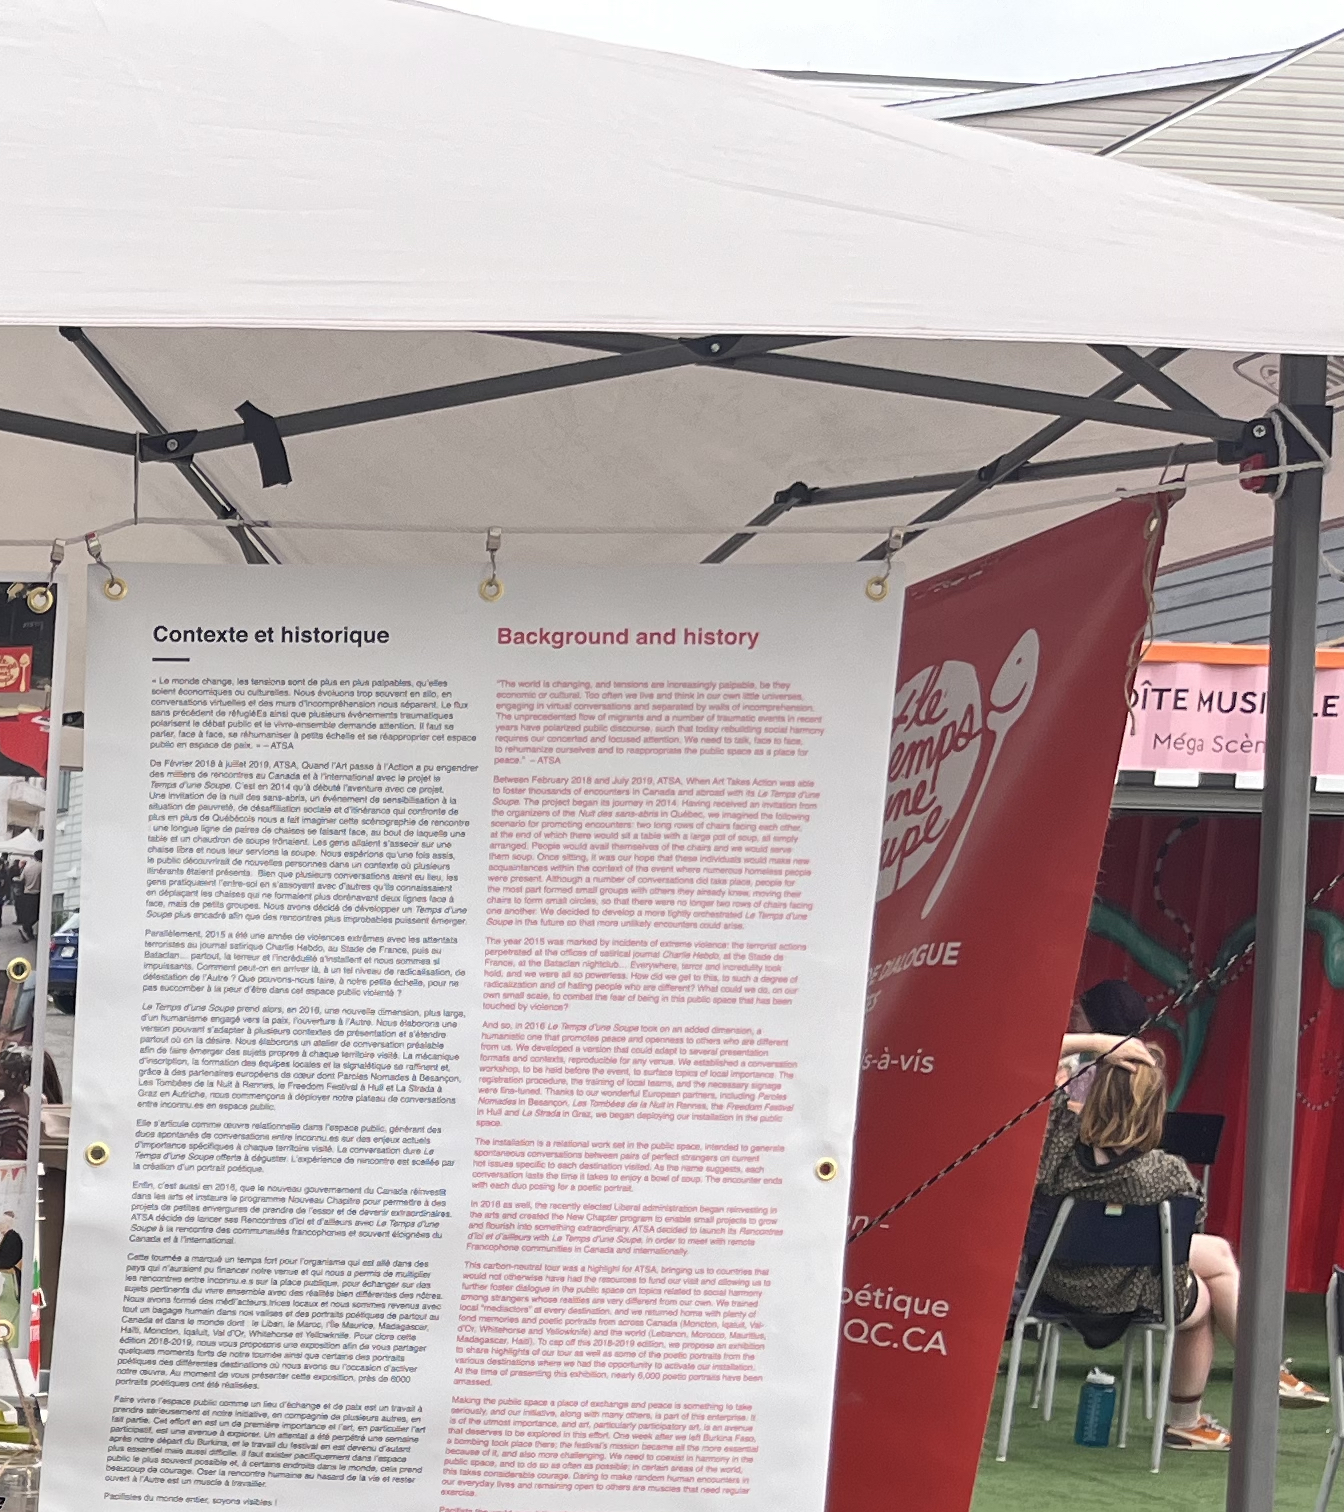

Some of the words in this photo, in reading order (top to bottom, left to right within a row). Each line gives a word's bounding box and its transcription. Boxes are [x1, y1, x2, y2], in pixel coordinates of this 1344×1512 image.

[153, 626, 248, 643] Contexte
[254, 628, 274, 643] et
[281, 626, 390, 647] historique
[497, 628, 629, 649] Background
[636, 628, 676, 645] and
[684, 628, 759, 650] history
[172, 678, 199, 686] monde
[201, 678, 234, 688] change,
[237, 678, 249, 686] les
[251, 678, 285, 687] tensions
[287, 679, 305, 687] sont
[307, 678, 318, 687] de
[320, 679, 338, 689] plus
[352, 679, 370, 690] plus
[372, 679, 414, 690] palpables,
[1197, 690, 1339, 717] MUSIE
[889, 703, 982, 794] emps
[1153, 732, 1204, 756] Méga
[1212, 733, 1266, 755] Scèn
[877, 942, 962, 982] DIALOGUE
[861, 1046, 934, 1073] s-à-vis
[842, 1283, 950, 1319] oétique
[843, 1319, 948, 1356] QC.CA
[143, 1494, 155, 1502] du
[156, 1494, 184, 1503] monde
[185, 1495, 210, 1505] entier,
[212, 1498, 241, 1507] soyons
